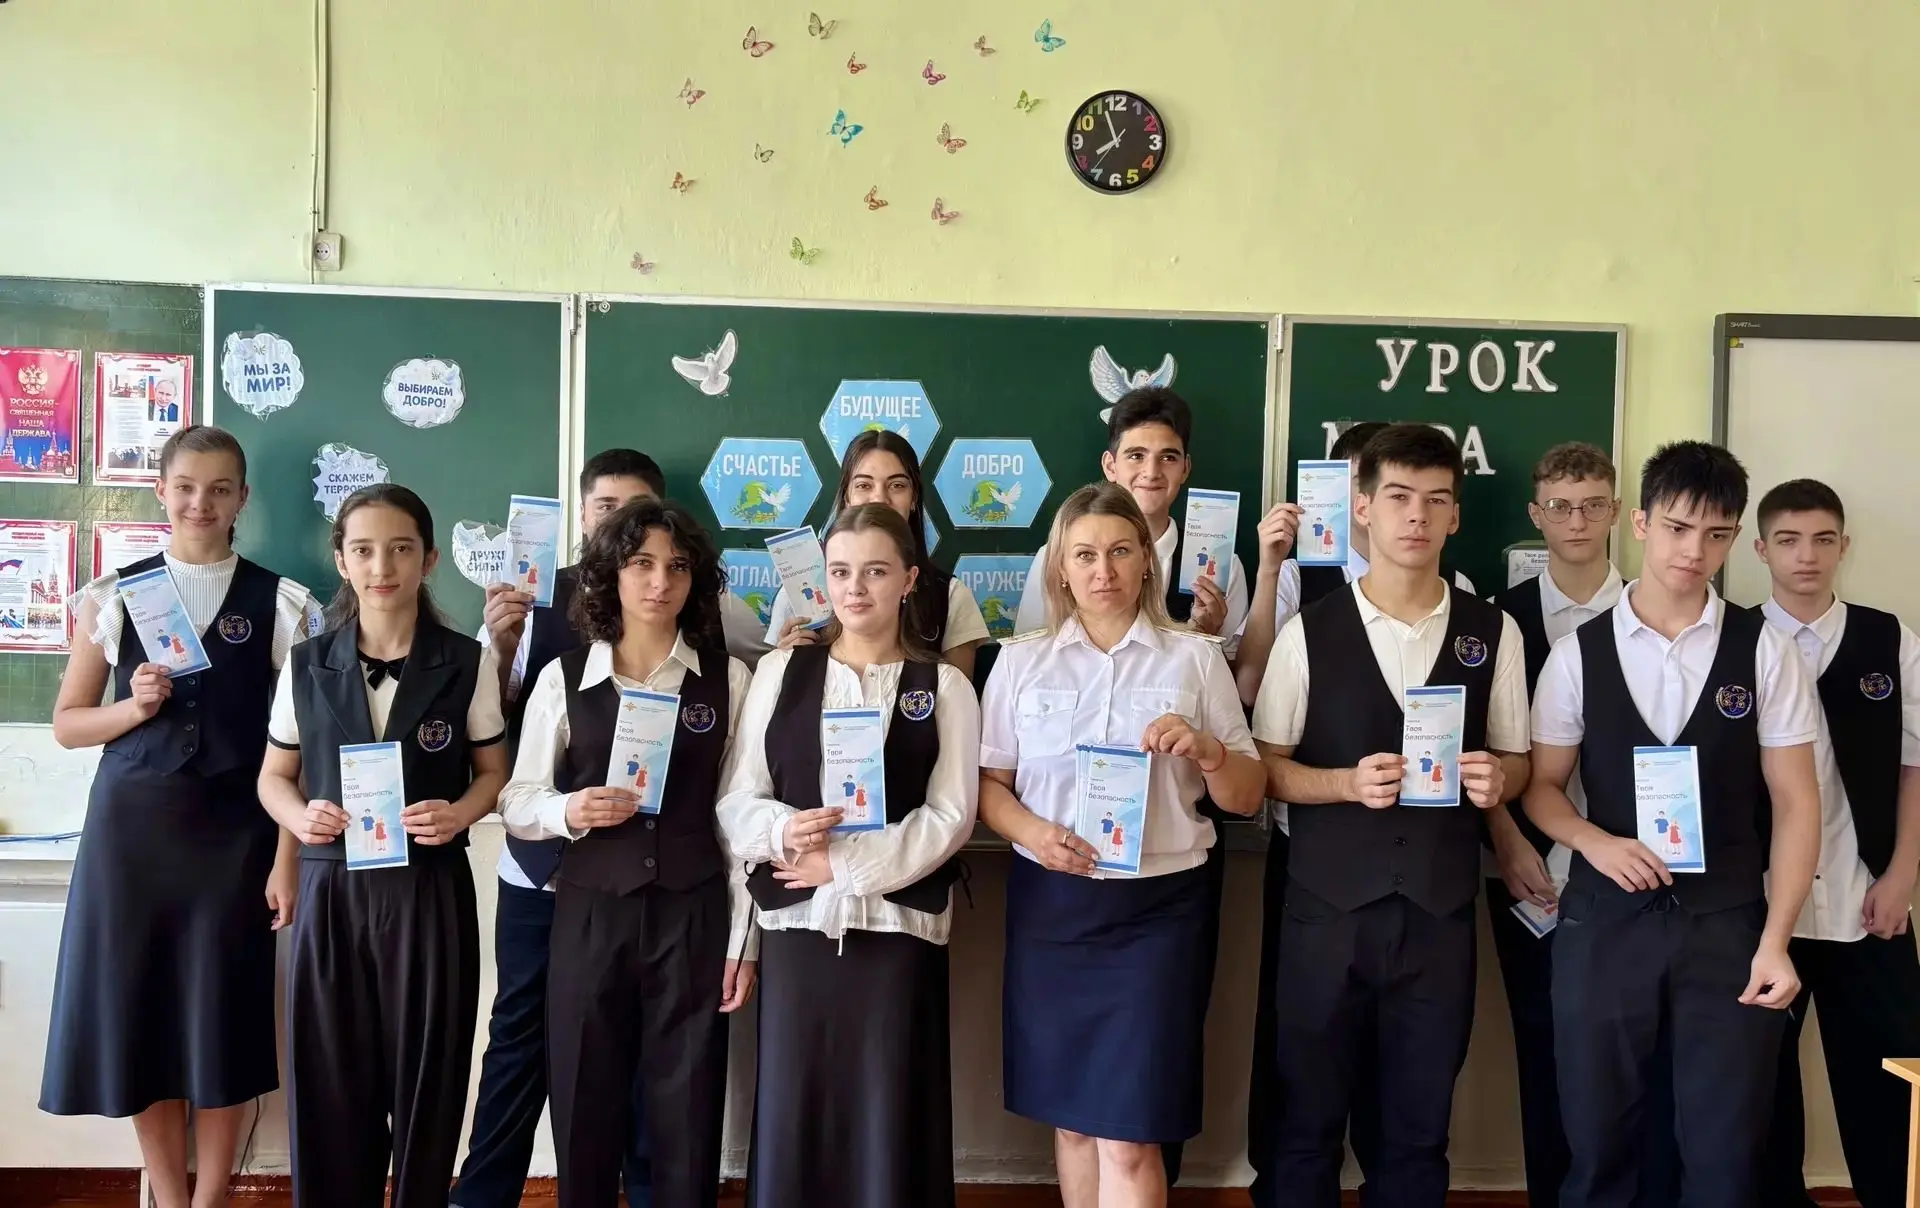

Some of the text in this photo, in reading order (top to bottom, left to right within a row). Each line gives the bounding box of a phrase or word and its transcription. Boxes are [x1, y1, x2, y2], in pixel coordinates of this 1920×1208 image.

[1088, 100, 1103, 115] 11
[1105, 96, 1127, 111] 12
[1132, 101, 1142, 115] 1
[1077, 115, 1094, 131] 10
[1144, 116, 1157, 132] 2
[1072, 134, 1084, 150] 9
[1149, 134, 1162, 150] 3
[1142, 155, 1154, 169] 4
[1090, 168, 1103, 182] 7
[1109, 173, 1122, 187] 6
[1126, 169, 1139, 184] 5
[244, 362, 291, 376] МЫ ЗА
[1376, 338, 1559, 392] УРОК
[247, 376, 291, 393] МИР!
[398, 382, 453, 396] ВЫБИРАЕМ
[402, 395, 446, 408] ДОБРО!
[840, 395, 922, 421] БУДУЩЕЕ
[18, 419, 44, 427] НАША
[12, 429, 52, 438] ДЕРЖАВА
[722, 454, 803, 478] СЧАСТЬЕ
[961, 454, 1024, 479] ДОБРО
[328, 473, 375, 483] СКАЖЕМ
[324, 485, 367, 494] ТЕРРОР
[467, 561, 504, 572] СИЛЬН
[728, 565, 781, 588] ОГЛАС
[960, 571, 1026, 592] ДРУЖБ
[616, 735, 664, 748] безопасность
[1405, 733, 1454, 741] безопасность
[1089, 783, 1106, 791] Твоя
[1088, 793, 1137, 804] безопасность
[1636, 793, 1688, 801] безопасность
